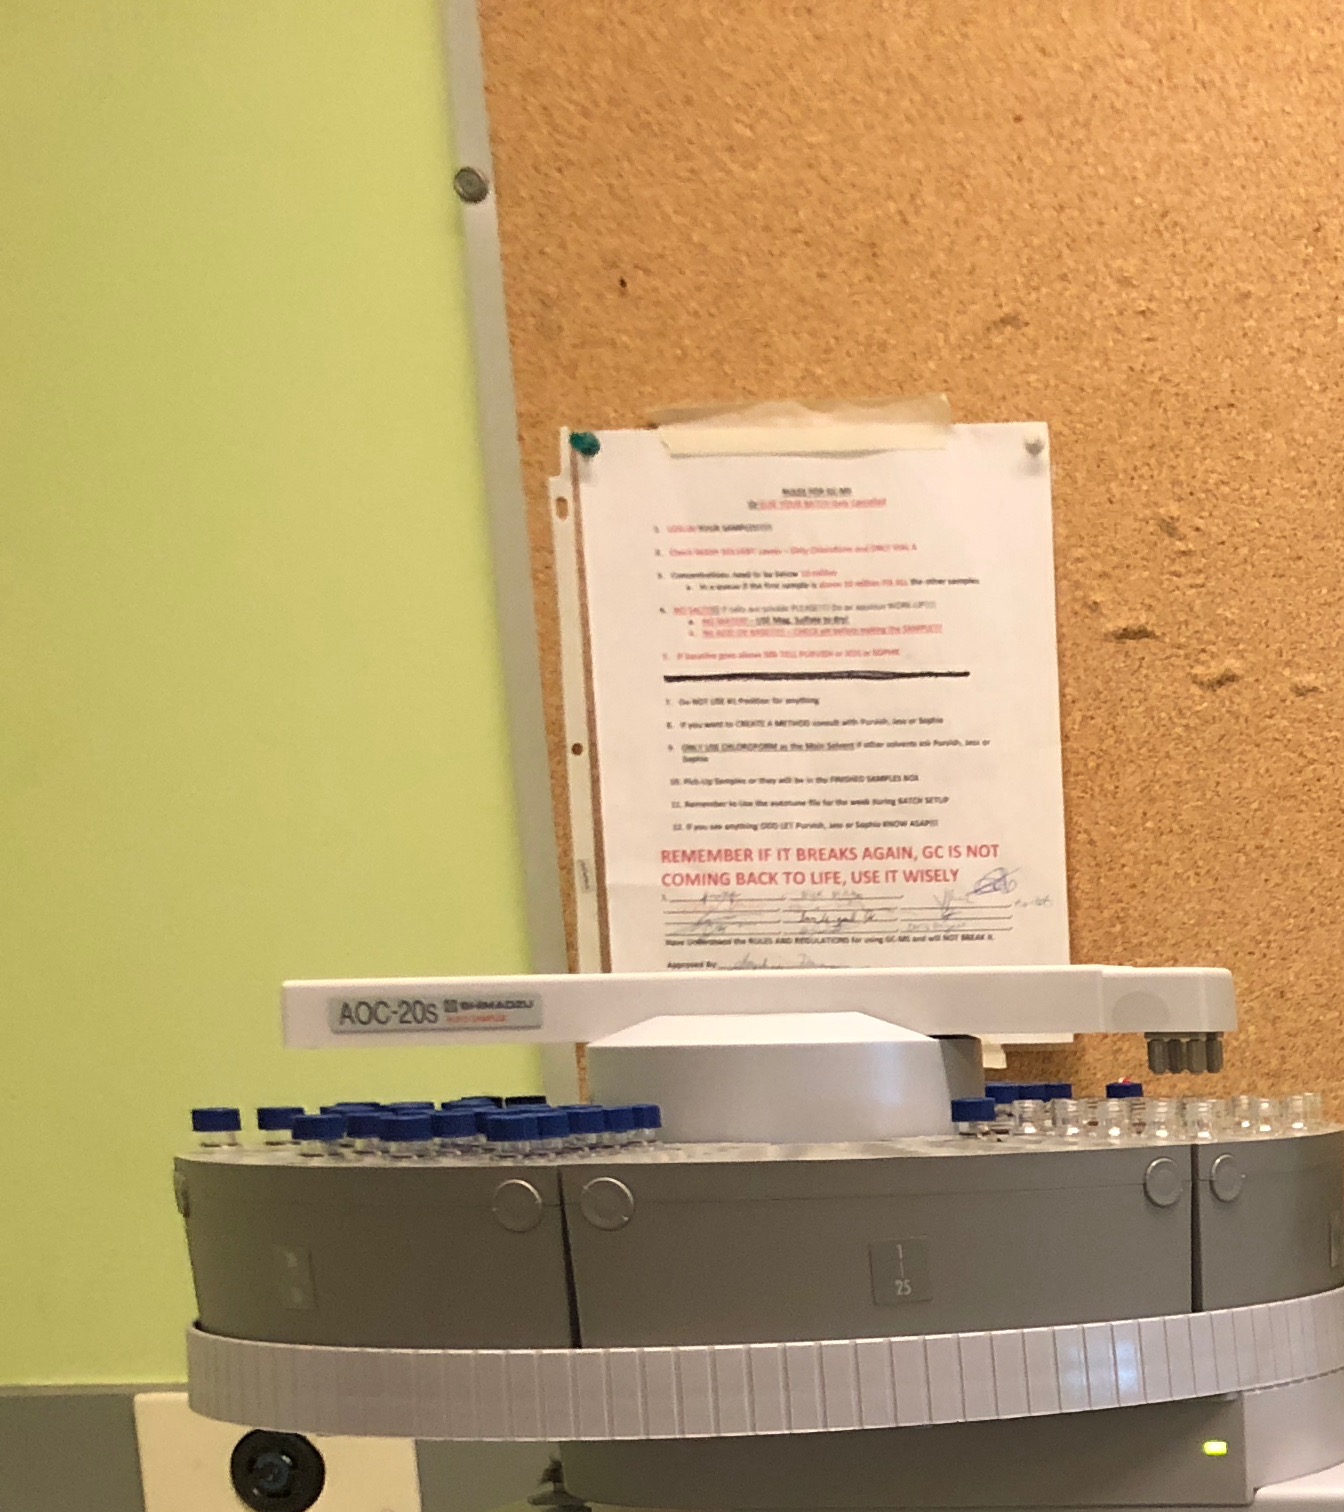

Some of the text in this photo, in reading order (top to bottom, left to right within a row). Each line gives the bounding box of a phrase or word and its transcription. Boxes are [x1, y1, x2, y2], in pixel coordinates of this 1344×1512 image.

[661, 844, 999, 863] REMEMBER IF IT BREAKS AGAIN, GC IS NOT
[661, 872, 731, 887] COMING
[736, 871, 778, 886] BACK
[782, 871, 806, 885] TO
[810, 870, 847, 886] LIFE,
[851, 870, 880, 884] USE
[885, 869, 899, 883] IT
[903, 868, 959, 883] WISELY
[338, 1000, 439, 1026] AOC-20s
